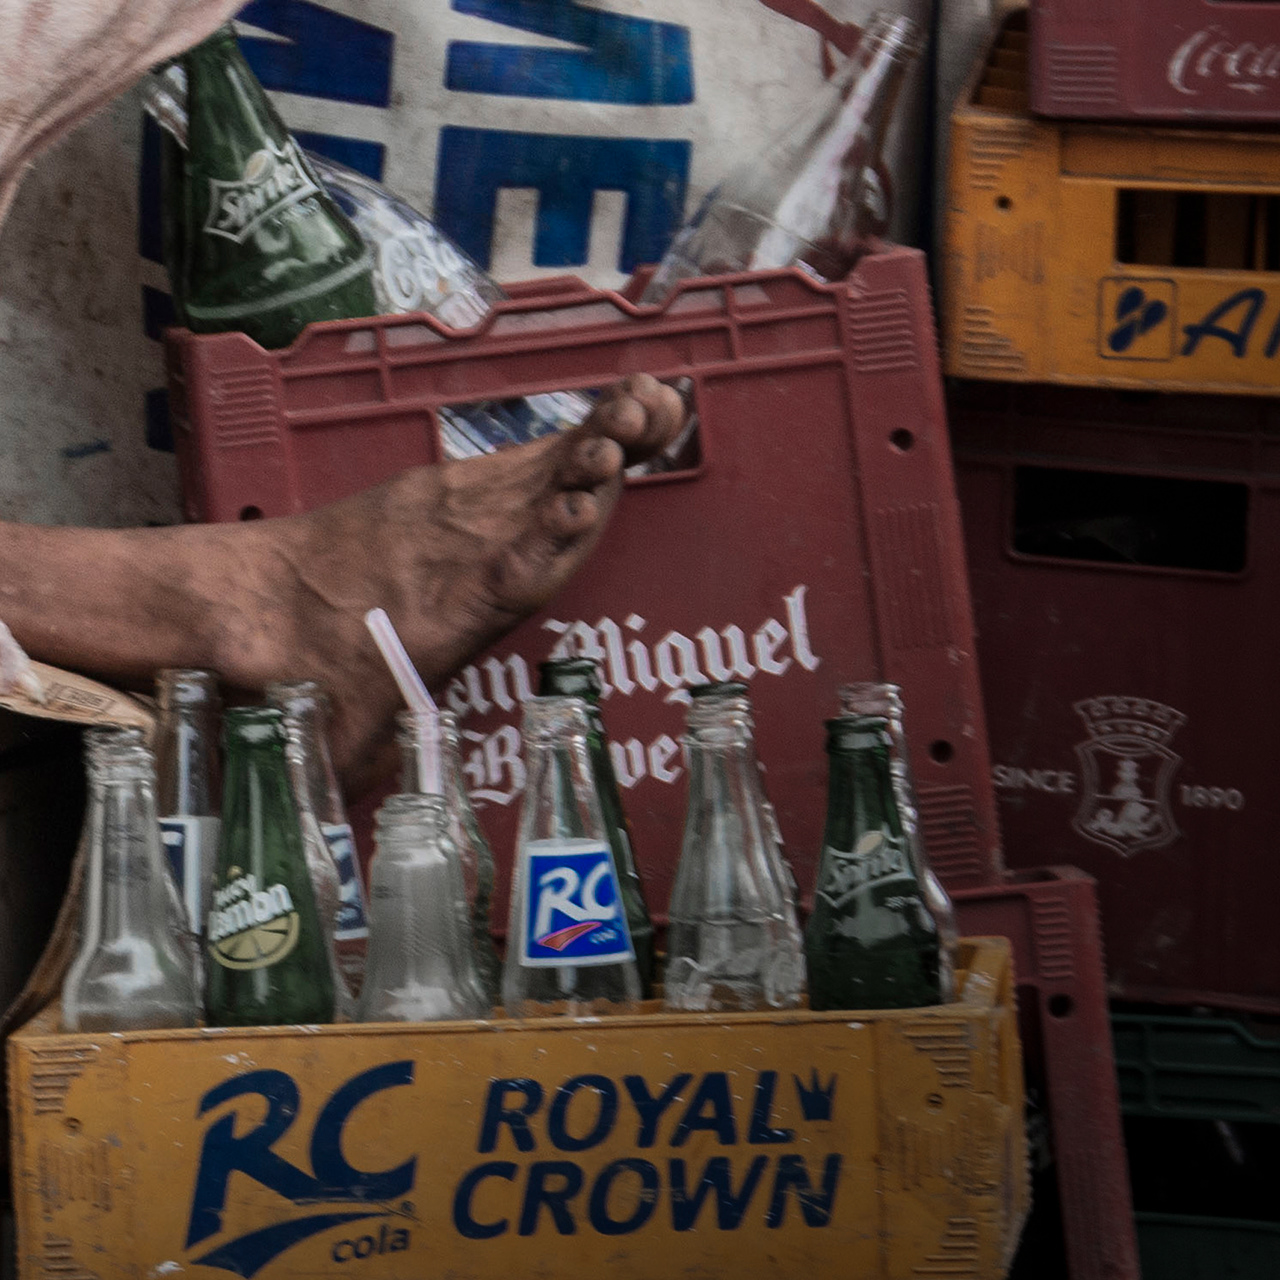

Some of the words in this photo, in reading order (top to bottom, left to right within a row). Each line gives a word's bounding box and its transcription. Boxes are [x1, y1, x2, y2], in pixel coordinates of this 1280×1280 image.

[445, 652, 535, 716] an
[541, 584, 822, 705] Miguel
[992, 764, 1078, 795] SINCE
[1179, 783, 1245, 811] 1890
[534, 860, 618, 941] RC
[476, 1070, 796, 1154] ROYAL
[184, 1060, 417, 1251] RC
[452, 1152, 844, 1240] CROWN
[332, 1222, 411, 1264] cola
